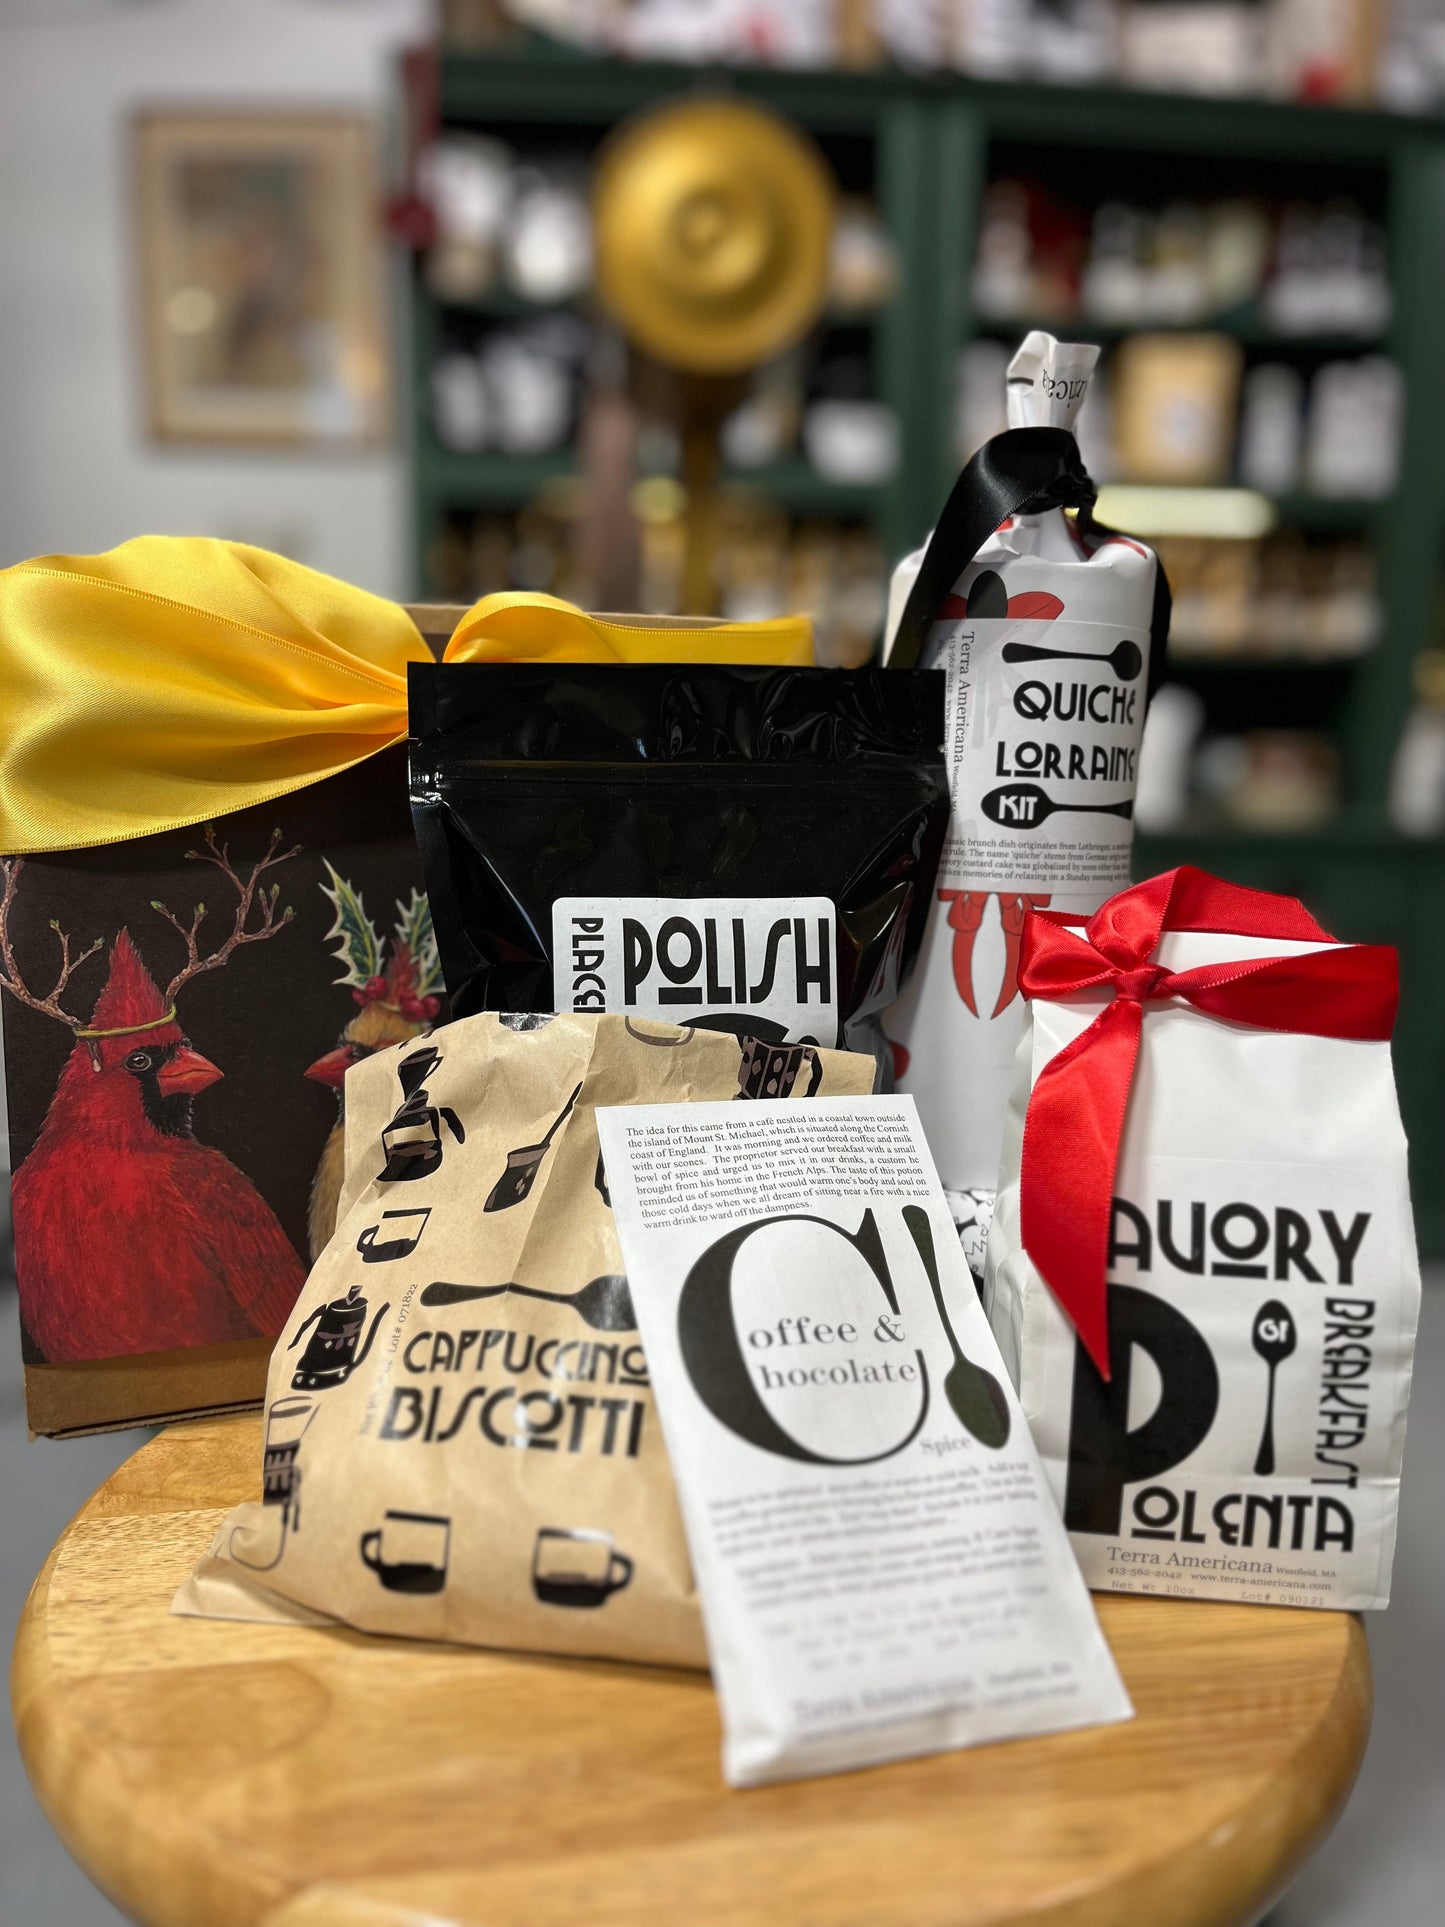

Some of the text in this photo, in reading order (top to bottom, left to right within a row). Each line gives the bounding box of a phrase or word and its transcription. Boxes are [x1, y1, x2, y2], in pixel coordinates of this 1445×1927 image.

[960, 632, 974, 674] Terra
[954, 680, 970, 762] Americana
[999, 796, 1038, 820] KIT
[968, 838, 996, 848] brunch
[998, 840, 1016, 848] dish
[1018, 840, 1057, 850] originates
[1060, 842, 1076, 850] from
[970, 848, 984, 857] The
[963, 860, 992, 868] custard
[1032, 862, 1070, 871] globalized
[963, 870, 1002, 878] memories
[1015, 872, 1047, 882] relaxing
[622, 916, 832, 1005] POLISH
[625, 1127, 644, 1136] The
[646, 1126, 665, 1135] idea
[666, 1125, 680, 1134] for
[681, 1124, 699, 1133] this
[700, 1124, 724, 1132] came
[725, 1121, 747, 1130] from
[755, 1117, 774, 1126] café
[776, 1115, 807, 1124] nestled
[824, 1114, 854, 1122] coastal
[876, 1113, 906, 1122] outside
[628, 1124, 910, 1148] the island of Mount St. Michael, which situated along the Cornish
[630, 1151, 654, 1160] coast
[656, 1148, 667, 1158] of
[668, 1145, 708, 1158] England.
[714, 1144, 723, 1152] It
[744, 1139, 782, 1149] morning
[784, 1135, 800, 1144] and
[816, 1134, 849, 1142] ordered
[850, 1134, 875, 1143] coffee
[877, 1135, 892, 1143] and
[893, 1134, 913, 1143] milk
[632, 1161, 653, 1171] with
[673, 1159, 707, 1168] scones.
[712, 1155, 731, 1164] The
[733, 1150, 777, 1164] proprietor
[779, 1145, 810, 1156] served
[826, 1144, 865, 1153] breakfast
[866, 1145, 885, 1153] with
[893, 1145, 916, 1153] small
[634, 1172, 658, 1183] bowl
[661, 1171, 672, 1181] of
[675, 1171, 699, 1181] spice
[702, 1166, 720, 1176] and
[722, 1163, 749, 1175] urged
[838, 1155, 867, 1164] drinks,
[908, 1155, 920, 1164] he
[636, 1183, 673, 1195] brought
[675, 1182, 698, 1191] from
[699, 1179, 714, 1188] his
[716, 1173, 742, 1186] home
[756, 1172, 770, 1181] the
[772, 1167, 804, 1179] French
[806, 1166, 828, 1176] Alps.
[829, 1165, 847, 1174] The
[869, 1166, 878, 1174] of
[879, 1166, 896, 1174] this
[896, 1168, 923, 1177] potion
[639, 1193, 684, 1207] reminded
[698, 1190, 708, 1200] of
[710, 1186, 758, 1198] something
[759, 1183, 777, 1192] that
[778, 1177, 808, 1189] would
[835, 1176, 858, 1185] one's
[857, 1176, 879, 1188] body
[880, 1177, 896, 1186] and
[897, 1176, 914, 1186] soul
[641, 1209, 666, 1218] those
[668, 1204, 690, 1215] cold
[691, 1203, 714, 1212] days
[715, 1199, 741, 1208] when
[758, 1194, 771, 1202] all
[772, 1191, 802, 1201] dream
[803, 1188, 813, 1197] of
[814, 1188, 843, 1197] sitting
[870, 1186, 885, 1196] fire
[886, 1188, 905, 1196] with
[643, 1202, 812, 1229] warm drink ward off the dampness.
[1107, 1196, 1372, 1286] AVORY
[388, 1282, 419, 1352] Lot# 071822
[873, 1314, 906, 1344] &
[403, 1329, 650, 1388] CAPPUCCINO
[1311, 1298, 1376, 1490] BREAKFAST
[379, 1386, 646, 1458] BISCOTTI
[920, 1435, 973, 1458] Spice
[1107, 1546, 1336, 1578] Terra Americana Westfield, MA
[1107, 1567, 1332, 1590] 413-562-2042 www.terra-americana.com
[1112, 1580, 1196, 1594] Net Wt 10oz
[1240, 1591, 1324, 1606] Lot# 090121
